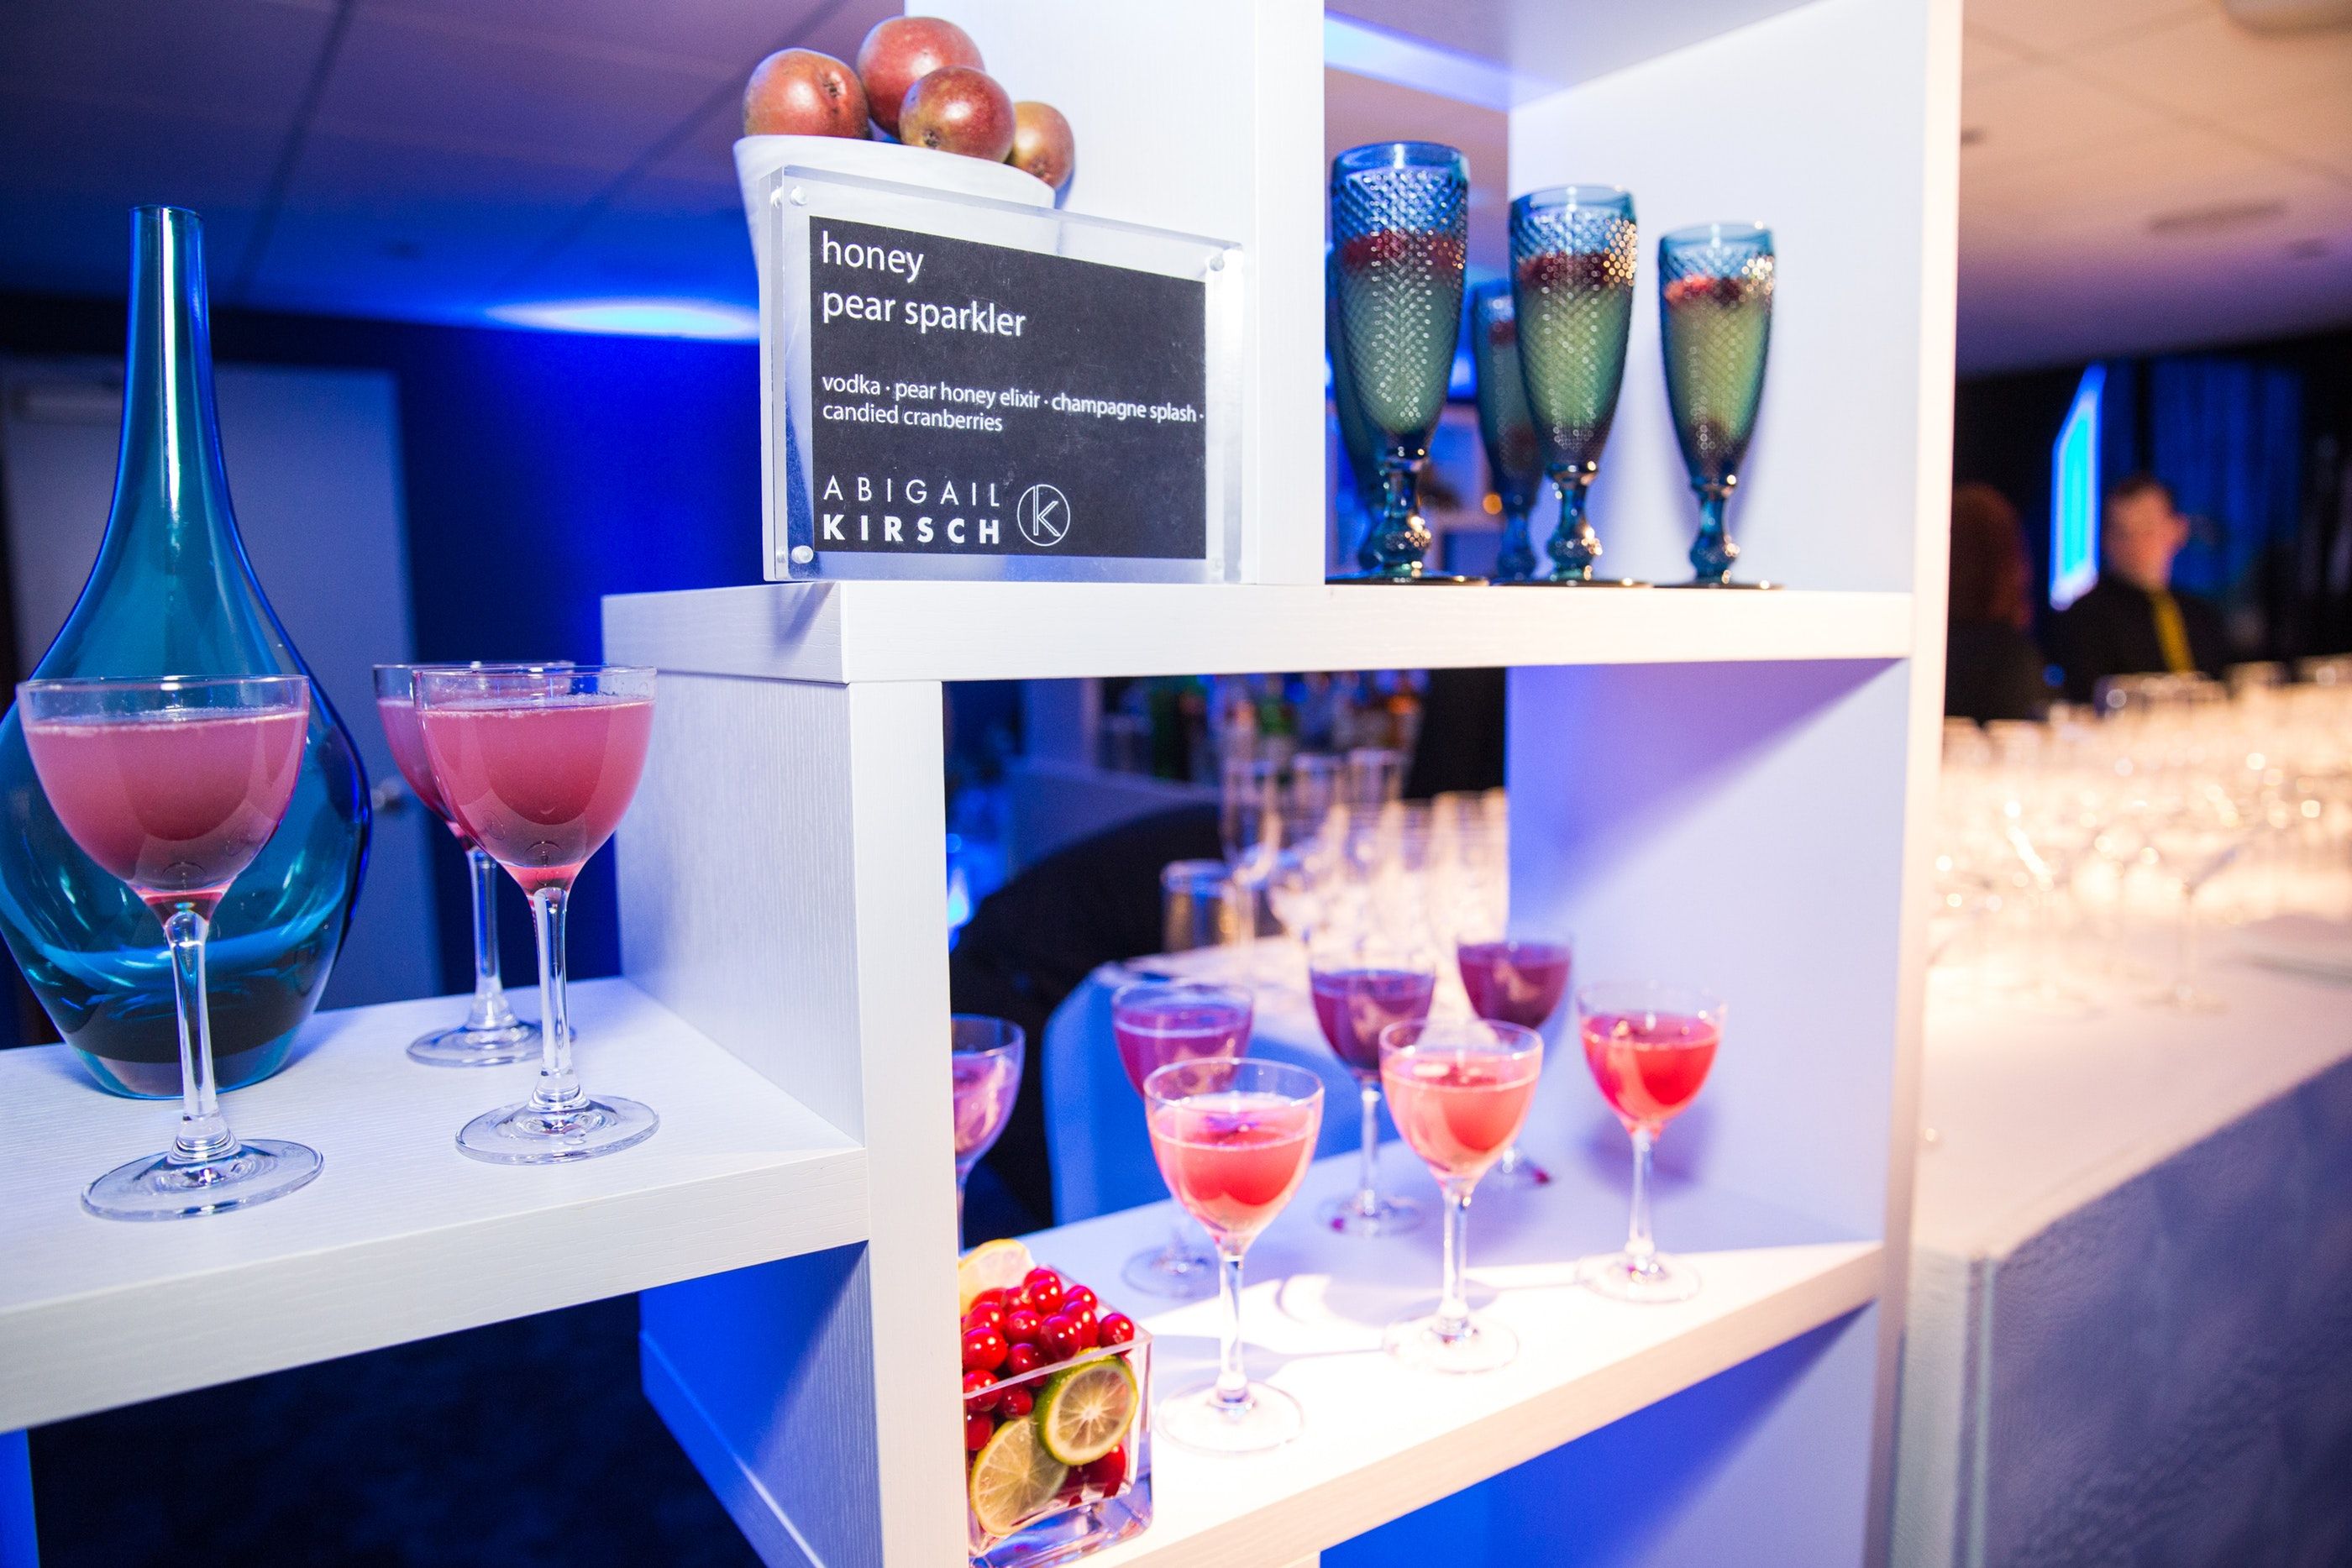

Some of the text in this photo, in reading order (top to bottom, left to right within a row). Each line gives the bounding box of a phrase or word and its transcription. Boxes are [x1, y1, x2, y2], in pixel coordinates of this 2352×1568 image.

[822, 230, 924, 282] honey
[822, 291, 1026, 337] pear sparkler
[822, 374, 1196, 423] vodka pear honey elixir champagne splash
[822, 402, 1003, 432] candied cranberries
[823, 475, 1000, 506] ABIGAIL
[823, 514, 999, 544] KIRSCH
